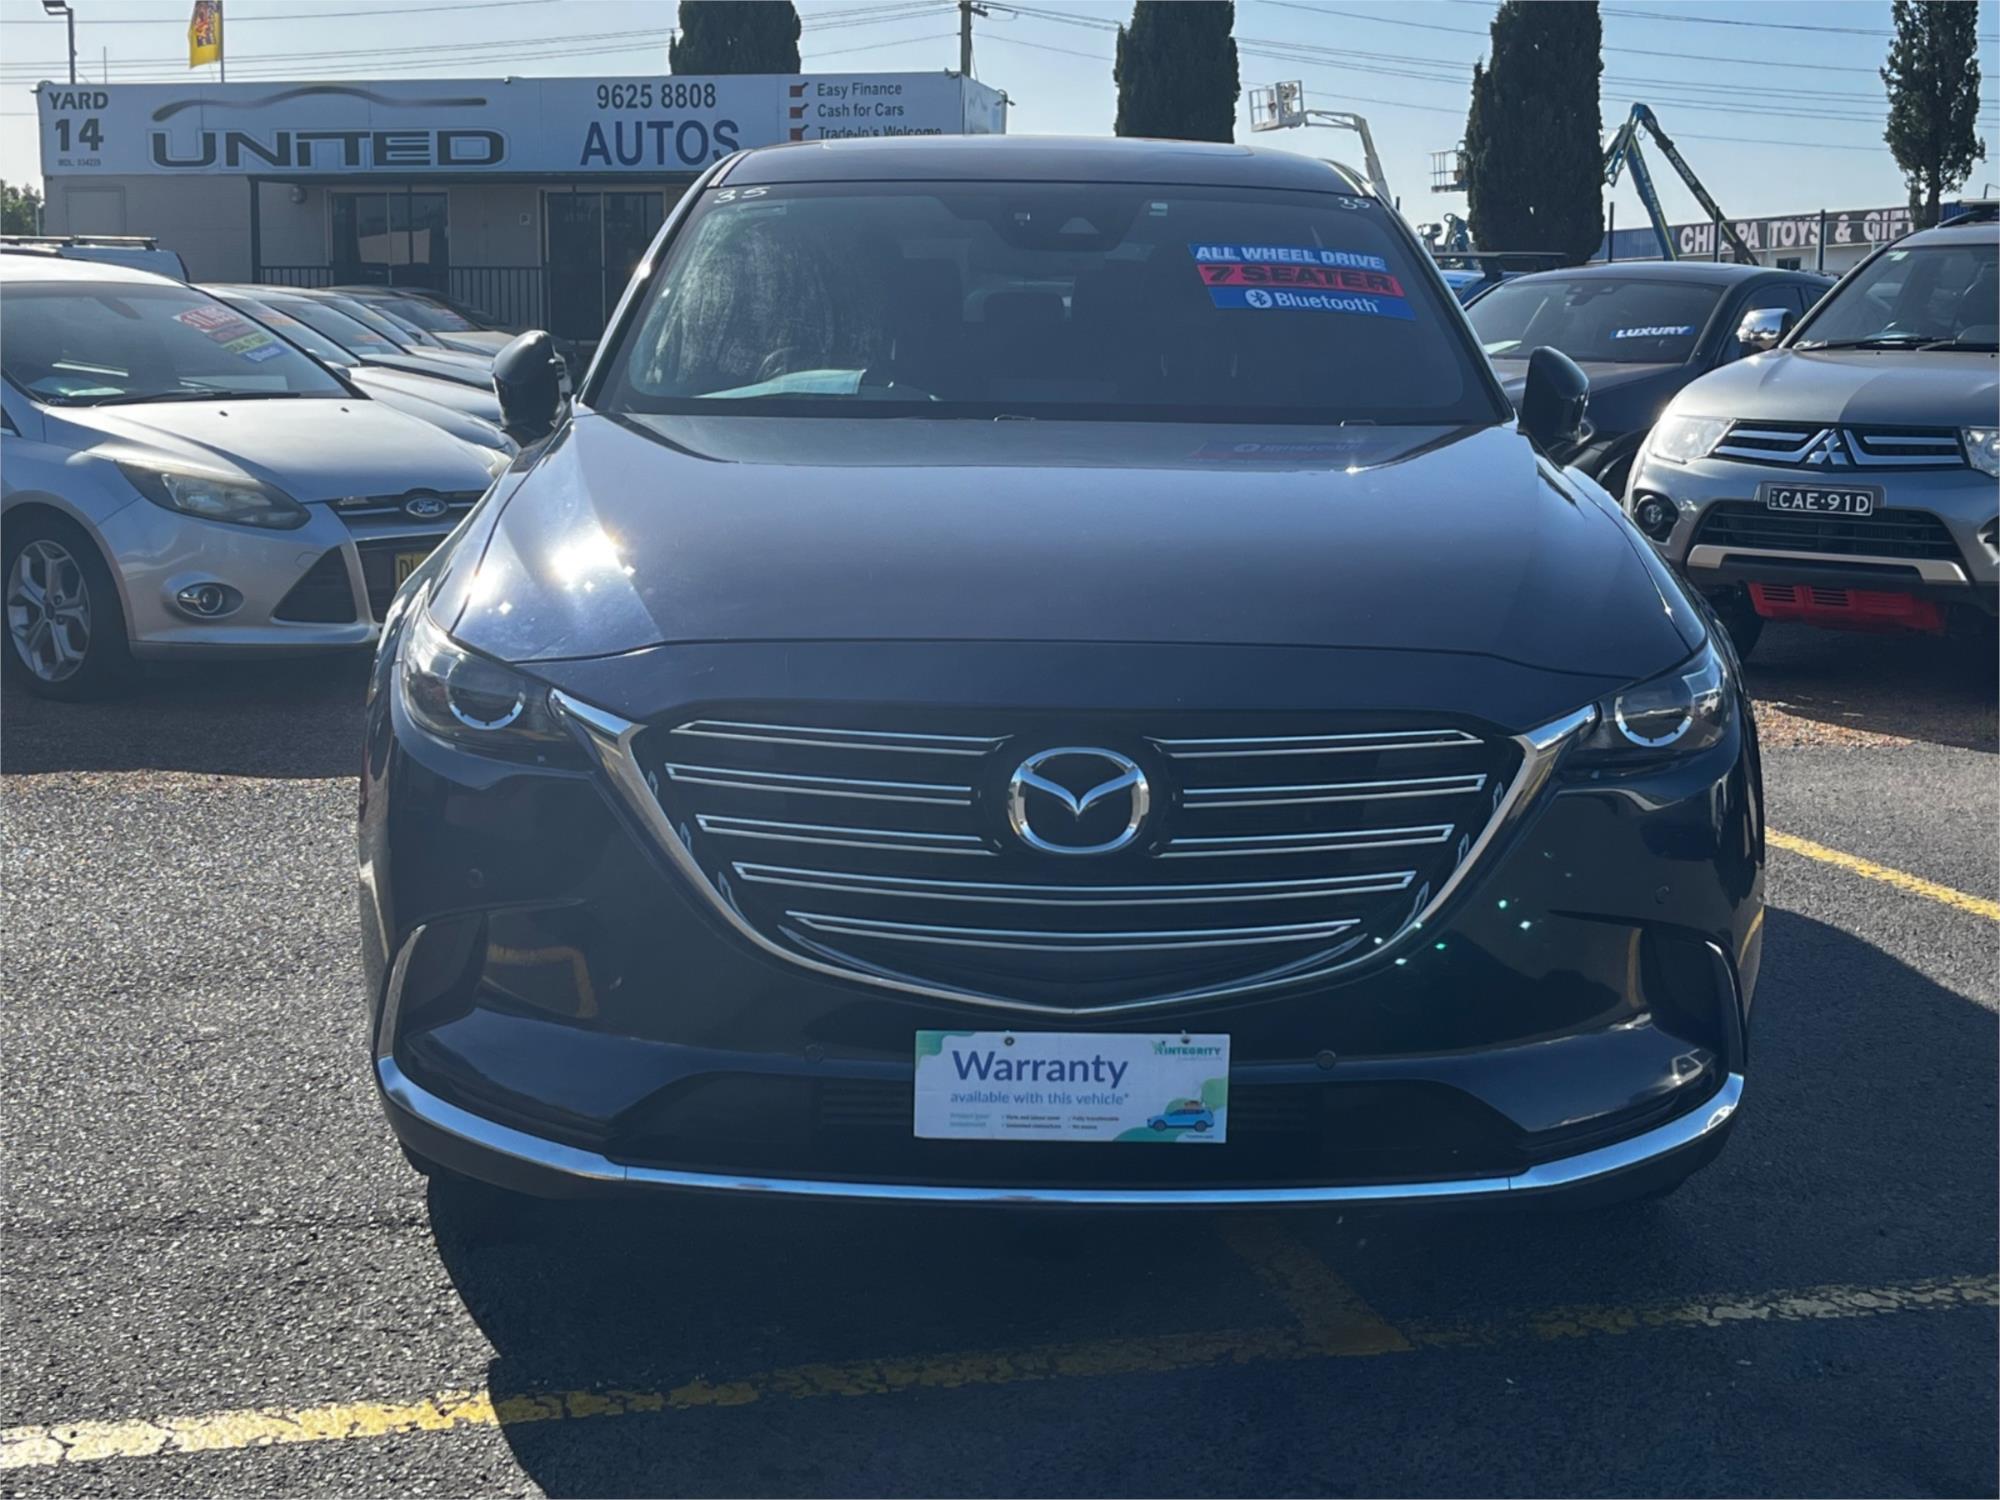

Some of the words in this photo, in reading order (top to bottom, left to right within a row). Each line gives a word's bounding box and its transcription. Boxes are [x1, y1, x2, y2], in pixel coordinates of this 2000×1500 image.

[48, 92, 109, 110] YARD
[597, 84, 652, 109] 9625
[661, 83, 716, 108] 8808
[817, 82, 848, 100] Easy
[852, 82, 902, 96] Finance
[818, 103, 849, 118] Cash
[853, 103, 871, 117] for
[874, 102, 905, 117] Cars
[55, 118, 104, 152] 14
[580, 120, 740, 167] AUTOS
[152, 130, 505, 167] UNITED
[713, 186, 771, 204] 35
[1771, 215, 1822, 248] TOYS
[1834, 213, 1853, 243] &
[1196, 246, 1241, 261] ALL
[1241, 247, 1319, 263] WHEEL
[1320, 250, 1387, 272] DRIVE
[1204, 265, 1234, 284] 7
[1241, 265, 1393, 292] SEATER
[1274, 292, 1379, 313] Bluetooth
[1615, 325, 1690, 339] LUXURY
[952, 1050, 1129, 1089] Warranty
[950, 1091, 1010, 1105] available
[1013, 1092, 1043, 1105] with
[1047, 1092, 1073, 1105] this
